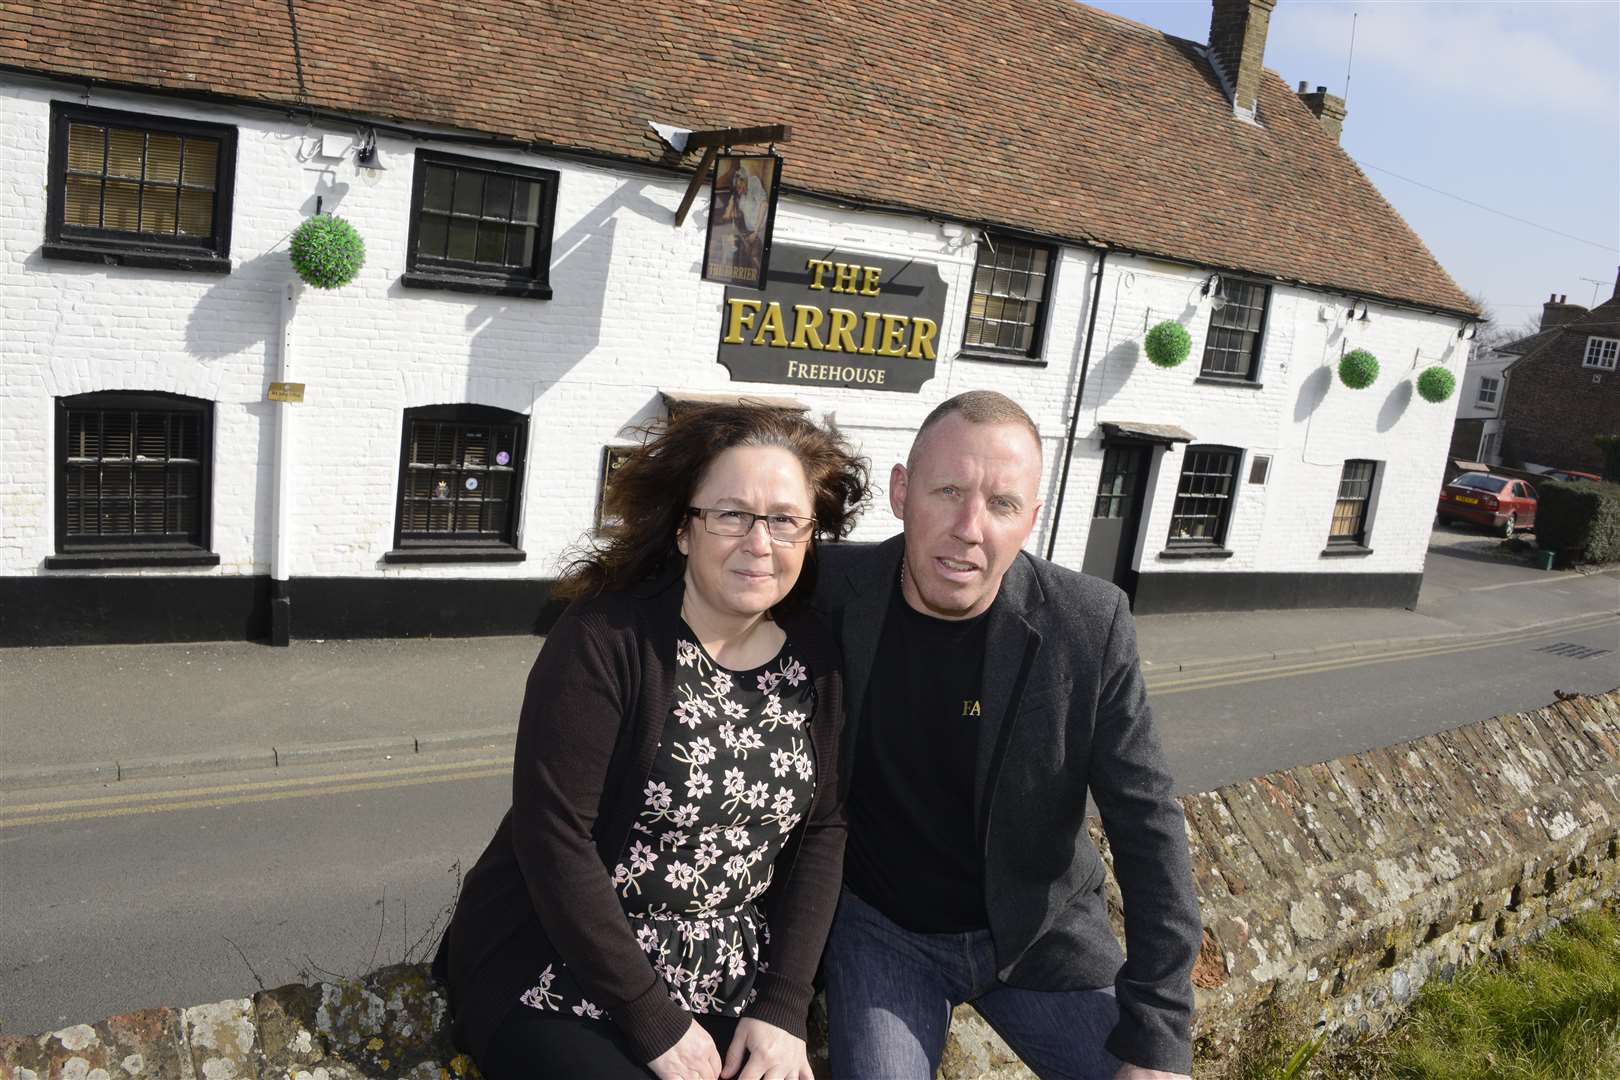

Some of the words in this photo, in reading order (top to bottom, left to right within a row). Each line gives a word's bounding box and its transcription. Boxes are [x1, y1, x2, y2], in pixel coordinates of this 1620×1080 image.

[806, 259, 883, 297] THE
[723, 298, 937, 360] FARRIER
[787, 360, 886, 384] FREEHOUSE
